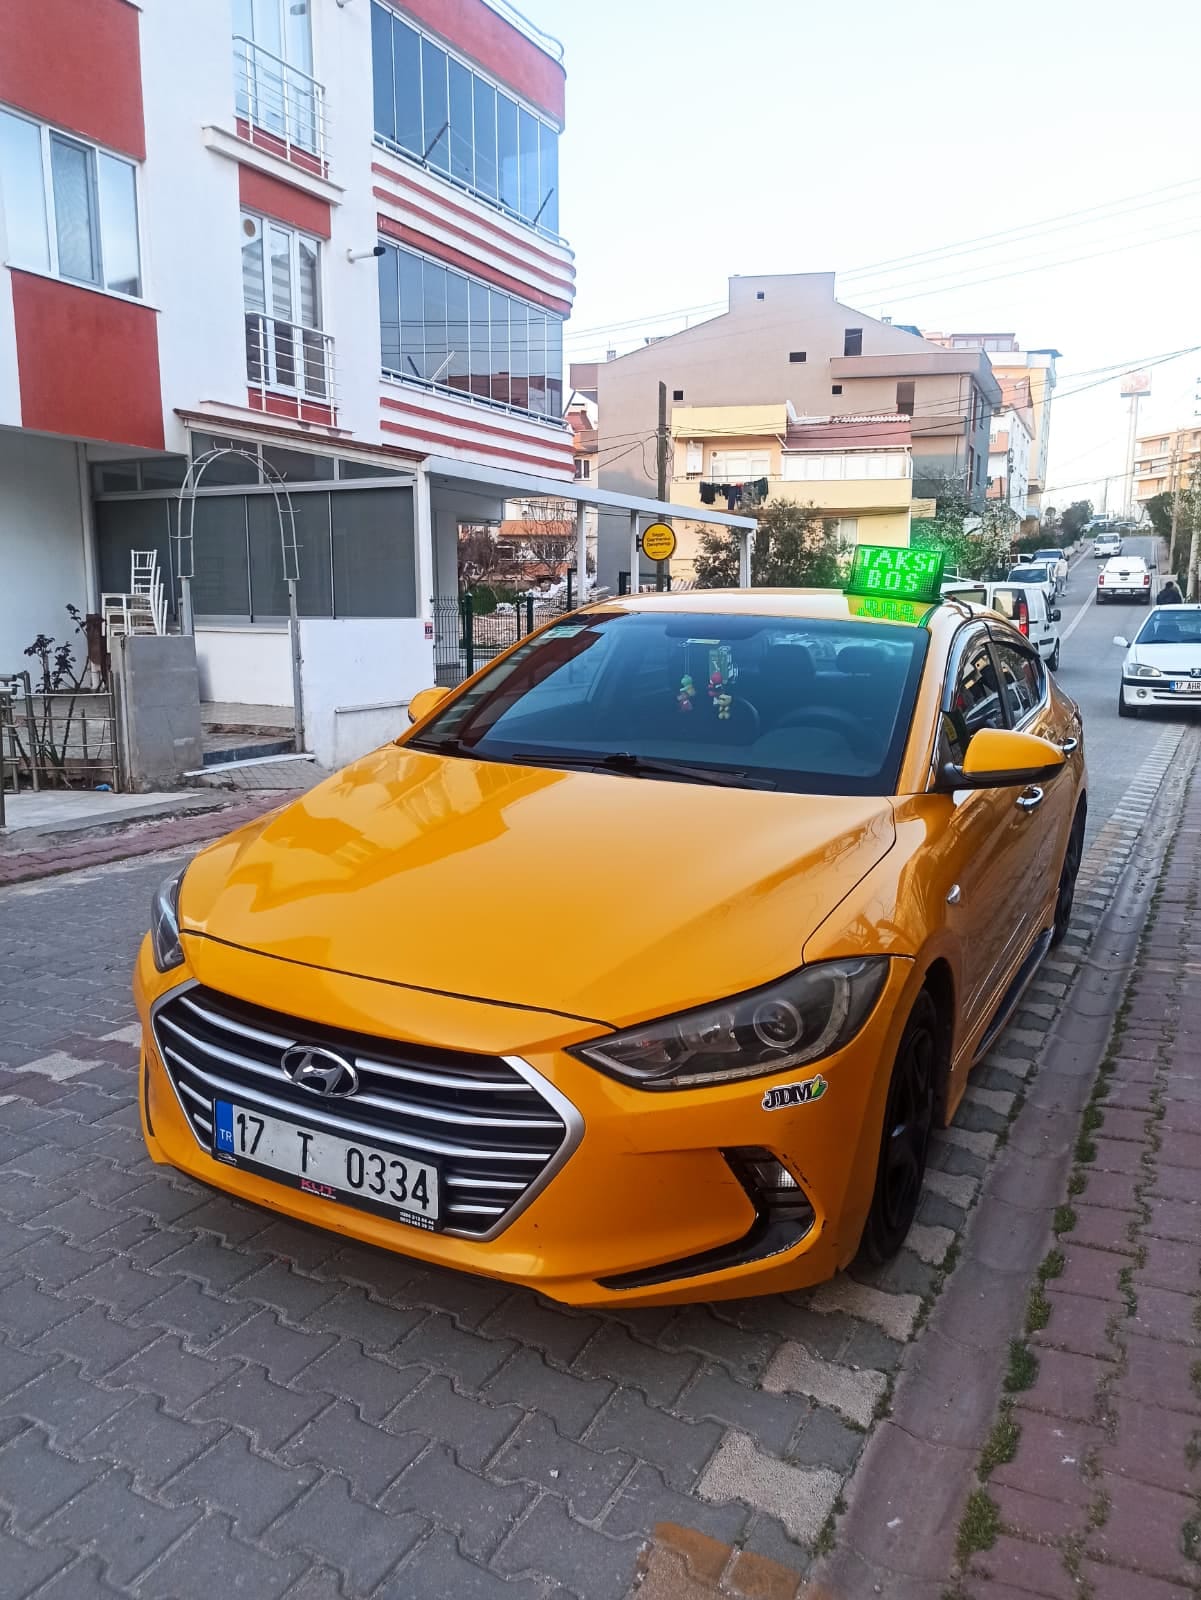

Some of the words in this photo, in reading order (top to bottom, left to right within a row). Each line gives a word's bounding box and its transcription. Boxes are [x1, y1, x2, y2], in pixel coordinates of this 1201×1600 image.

[1175, 682, 1184, 690] 17
[763, 1081, 814, 1109] JDM
[219, 1128, 233, 1143] TR
[237, 1113, 265, 1155] 17
[297, 1130, 314, 1173] T
[346, 1147, 430, 1210] 0334
